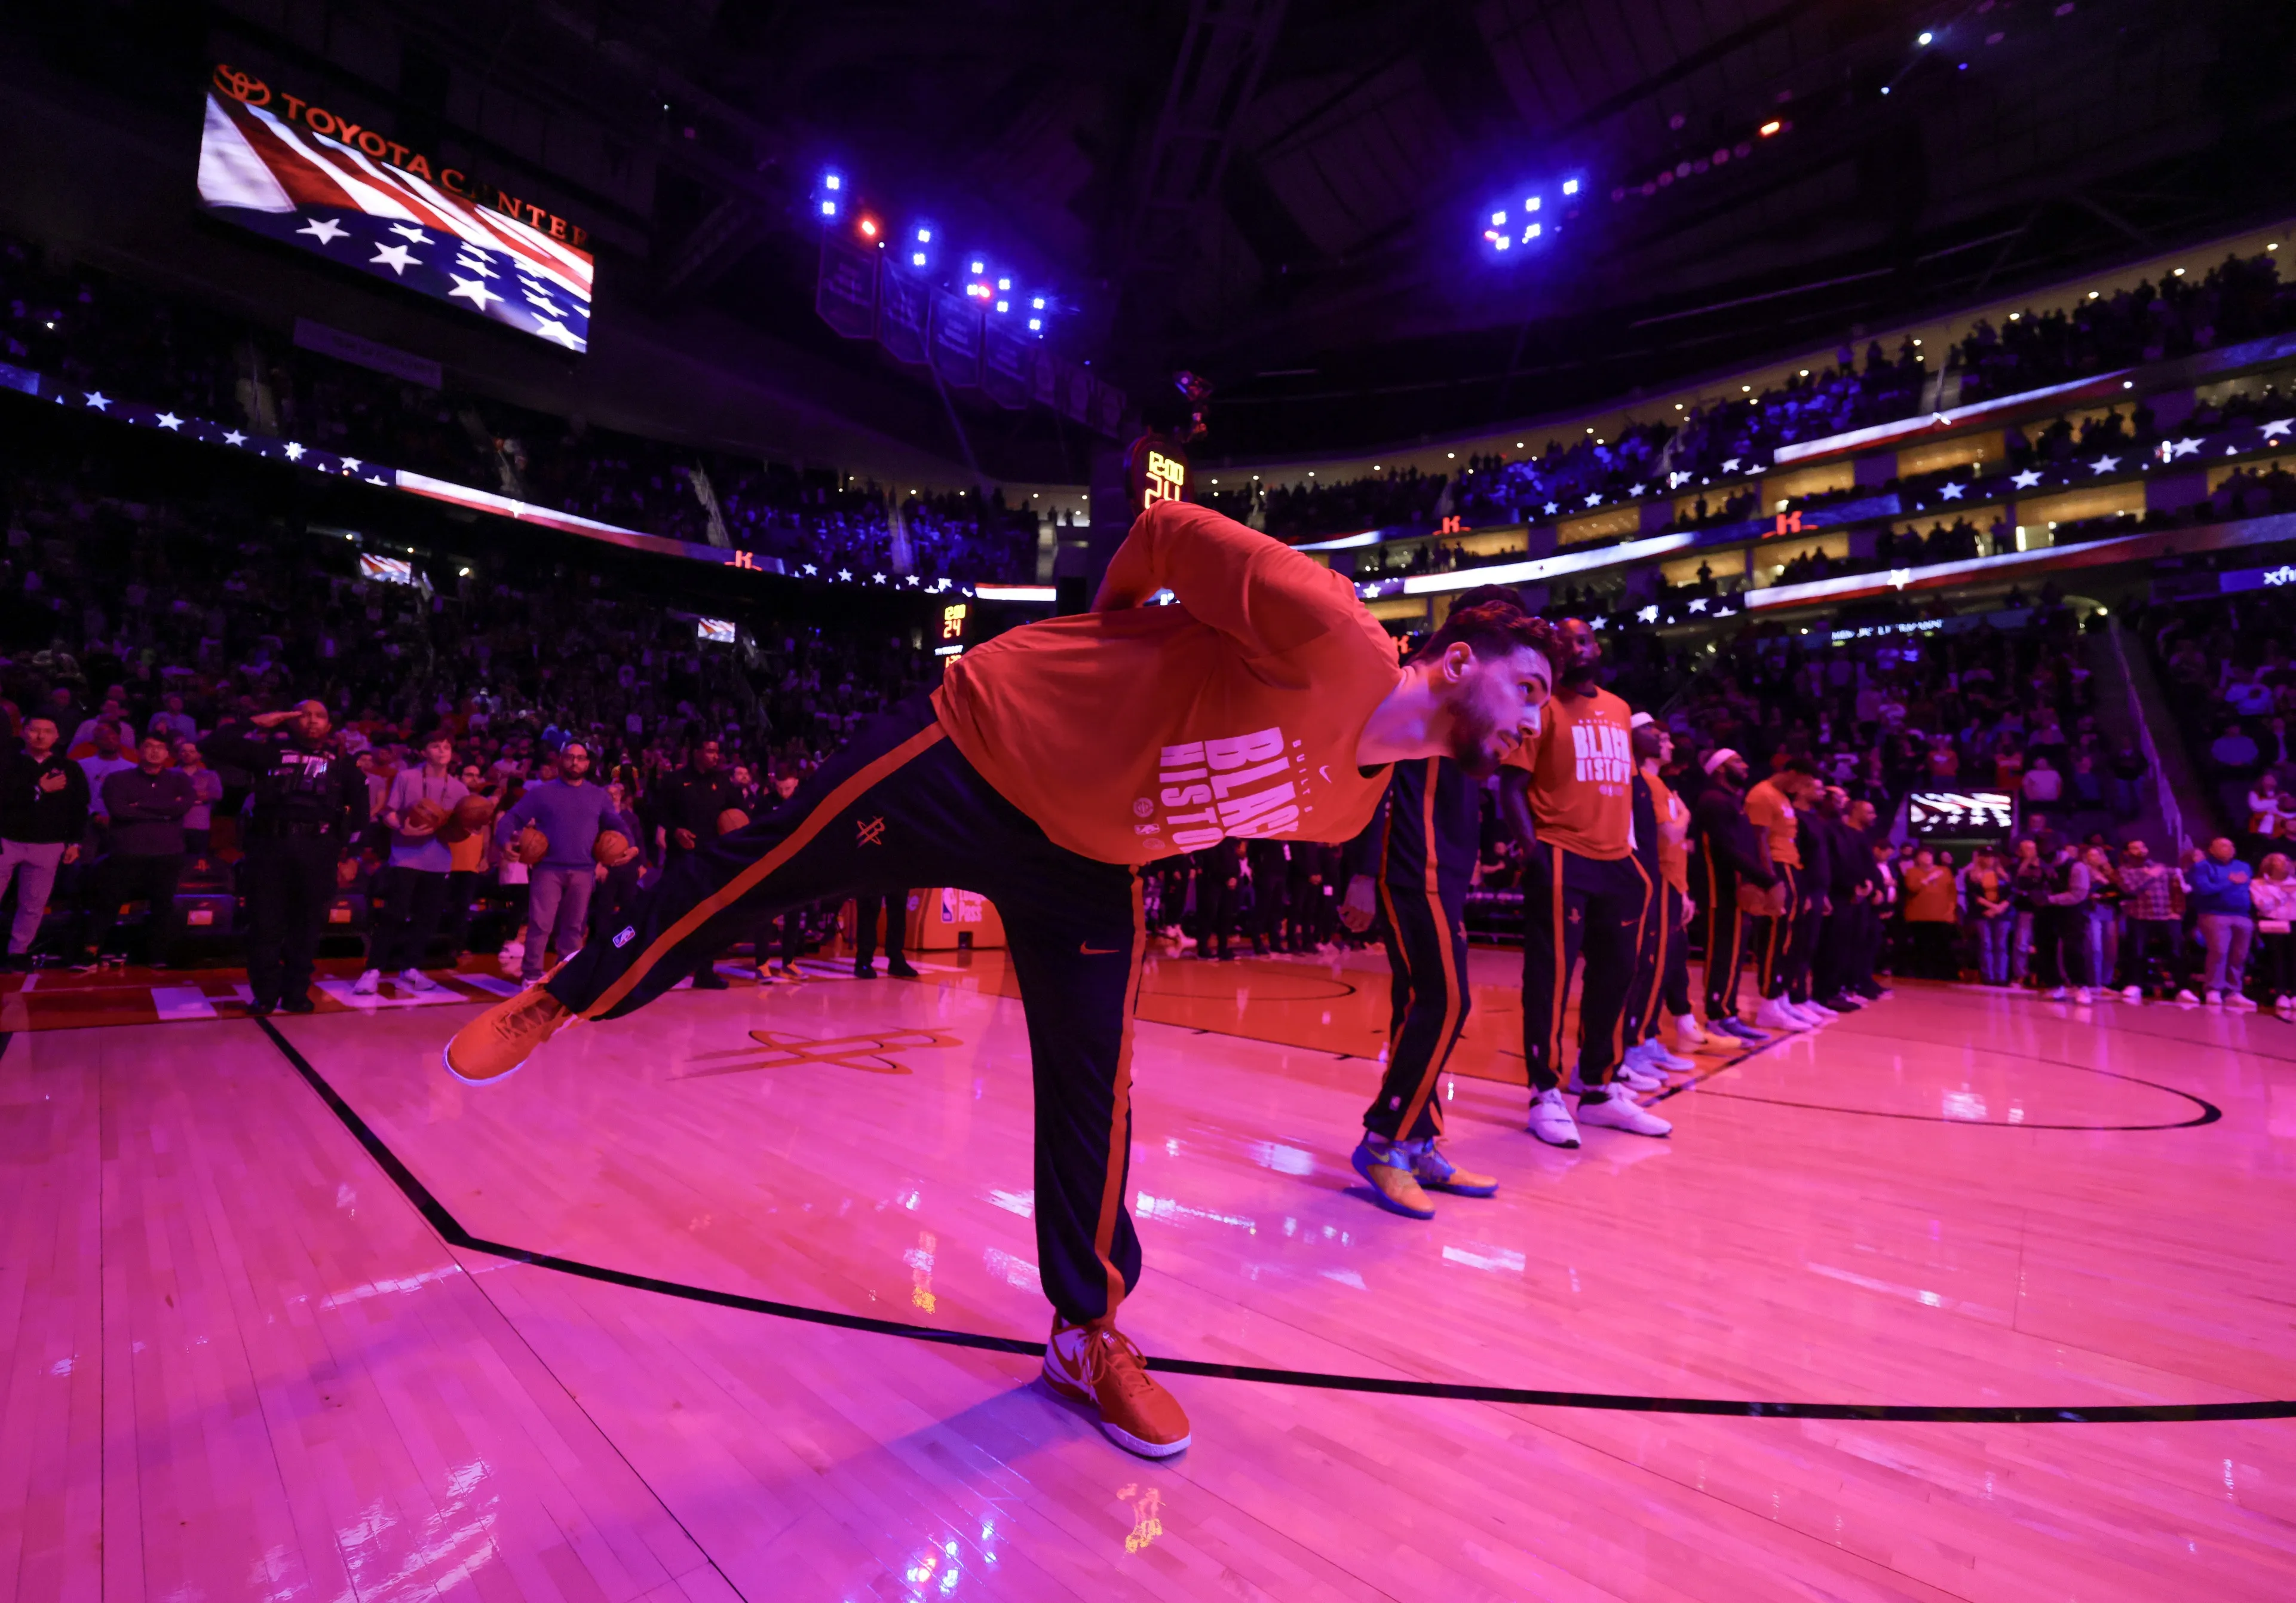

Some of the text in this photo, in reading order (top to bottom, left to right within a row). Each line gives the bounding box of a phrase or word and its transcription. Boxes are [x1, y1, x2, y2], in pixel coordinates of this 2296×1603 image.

[281, 92, 587, 246] TOYOTA CNTER
[2263, 565, 2296, 586] xfi
[943, 618, 961, 638] 24
[1292, 738, 1311, 795] BUILT
